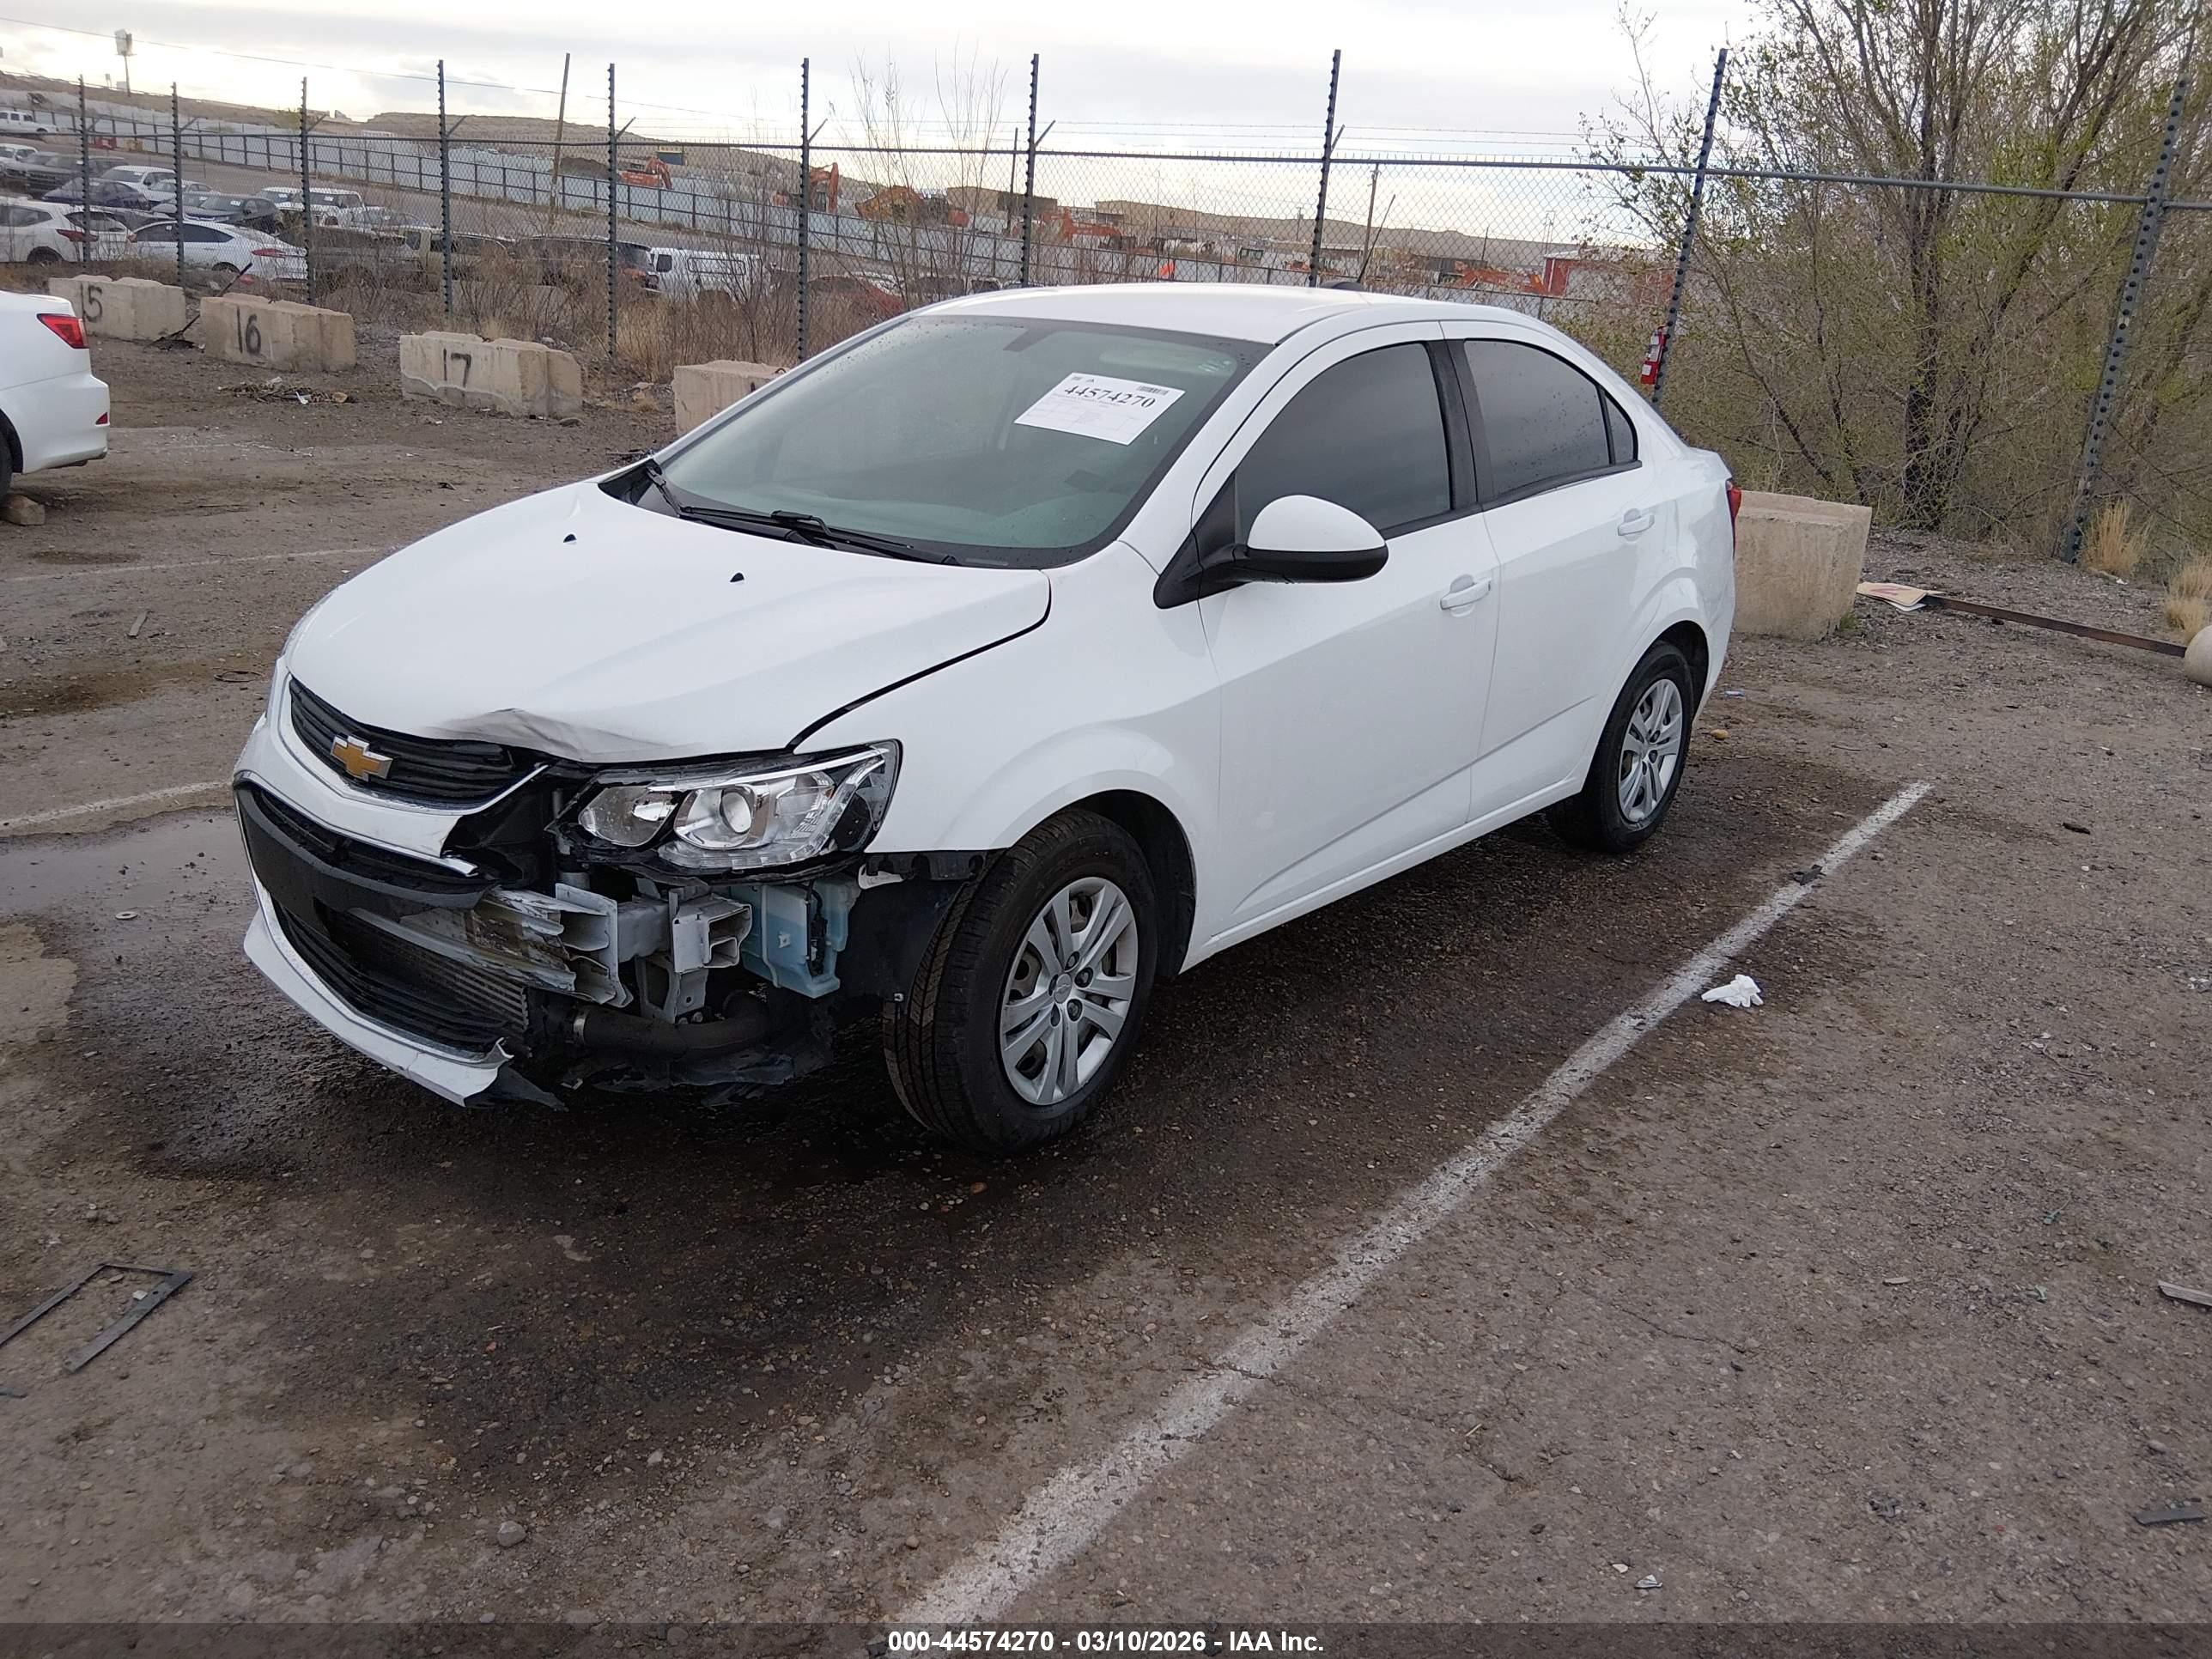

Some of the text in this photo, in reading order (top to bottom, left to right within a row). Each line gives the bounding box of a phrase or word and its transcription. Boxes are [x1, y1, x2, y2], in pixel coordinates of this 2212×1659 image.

[81, 283, 104, 322] 15
[236, 306, 262, 356] 16
[442, 348, 472, 388] 17
[1064, 386, 1156, 408] 44574270
